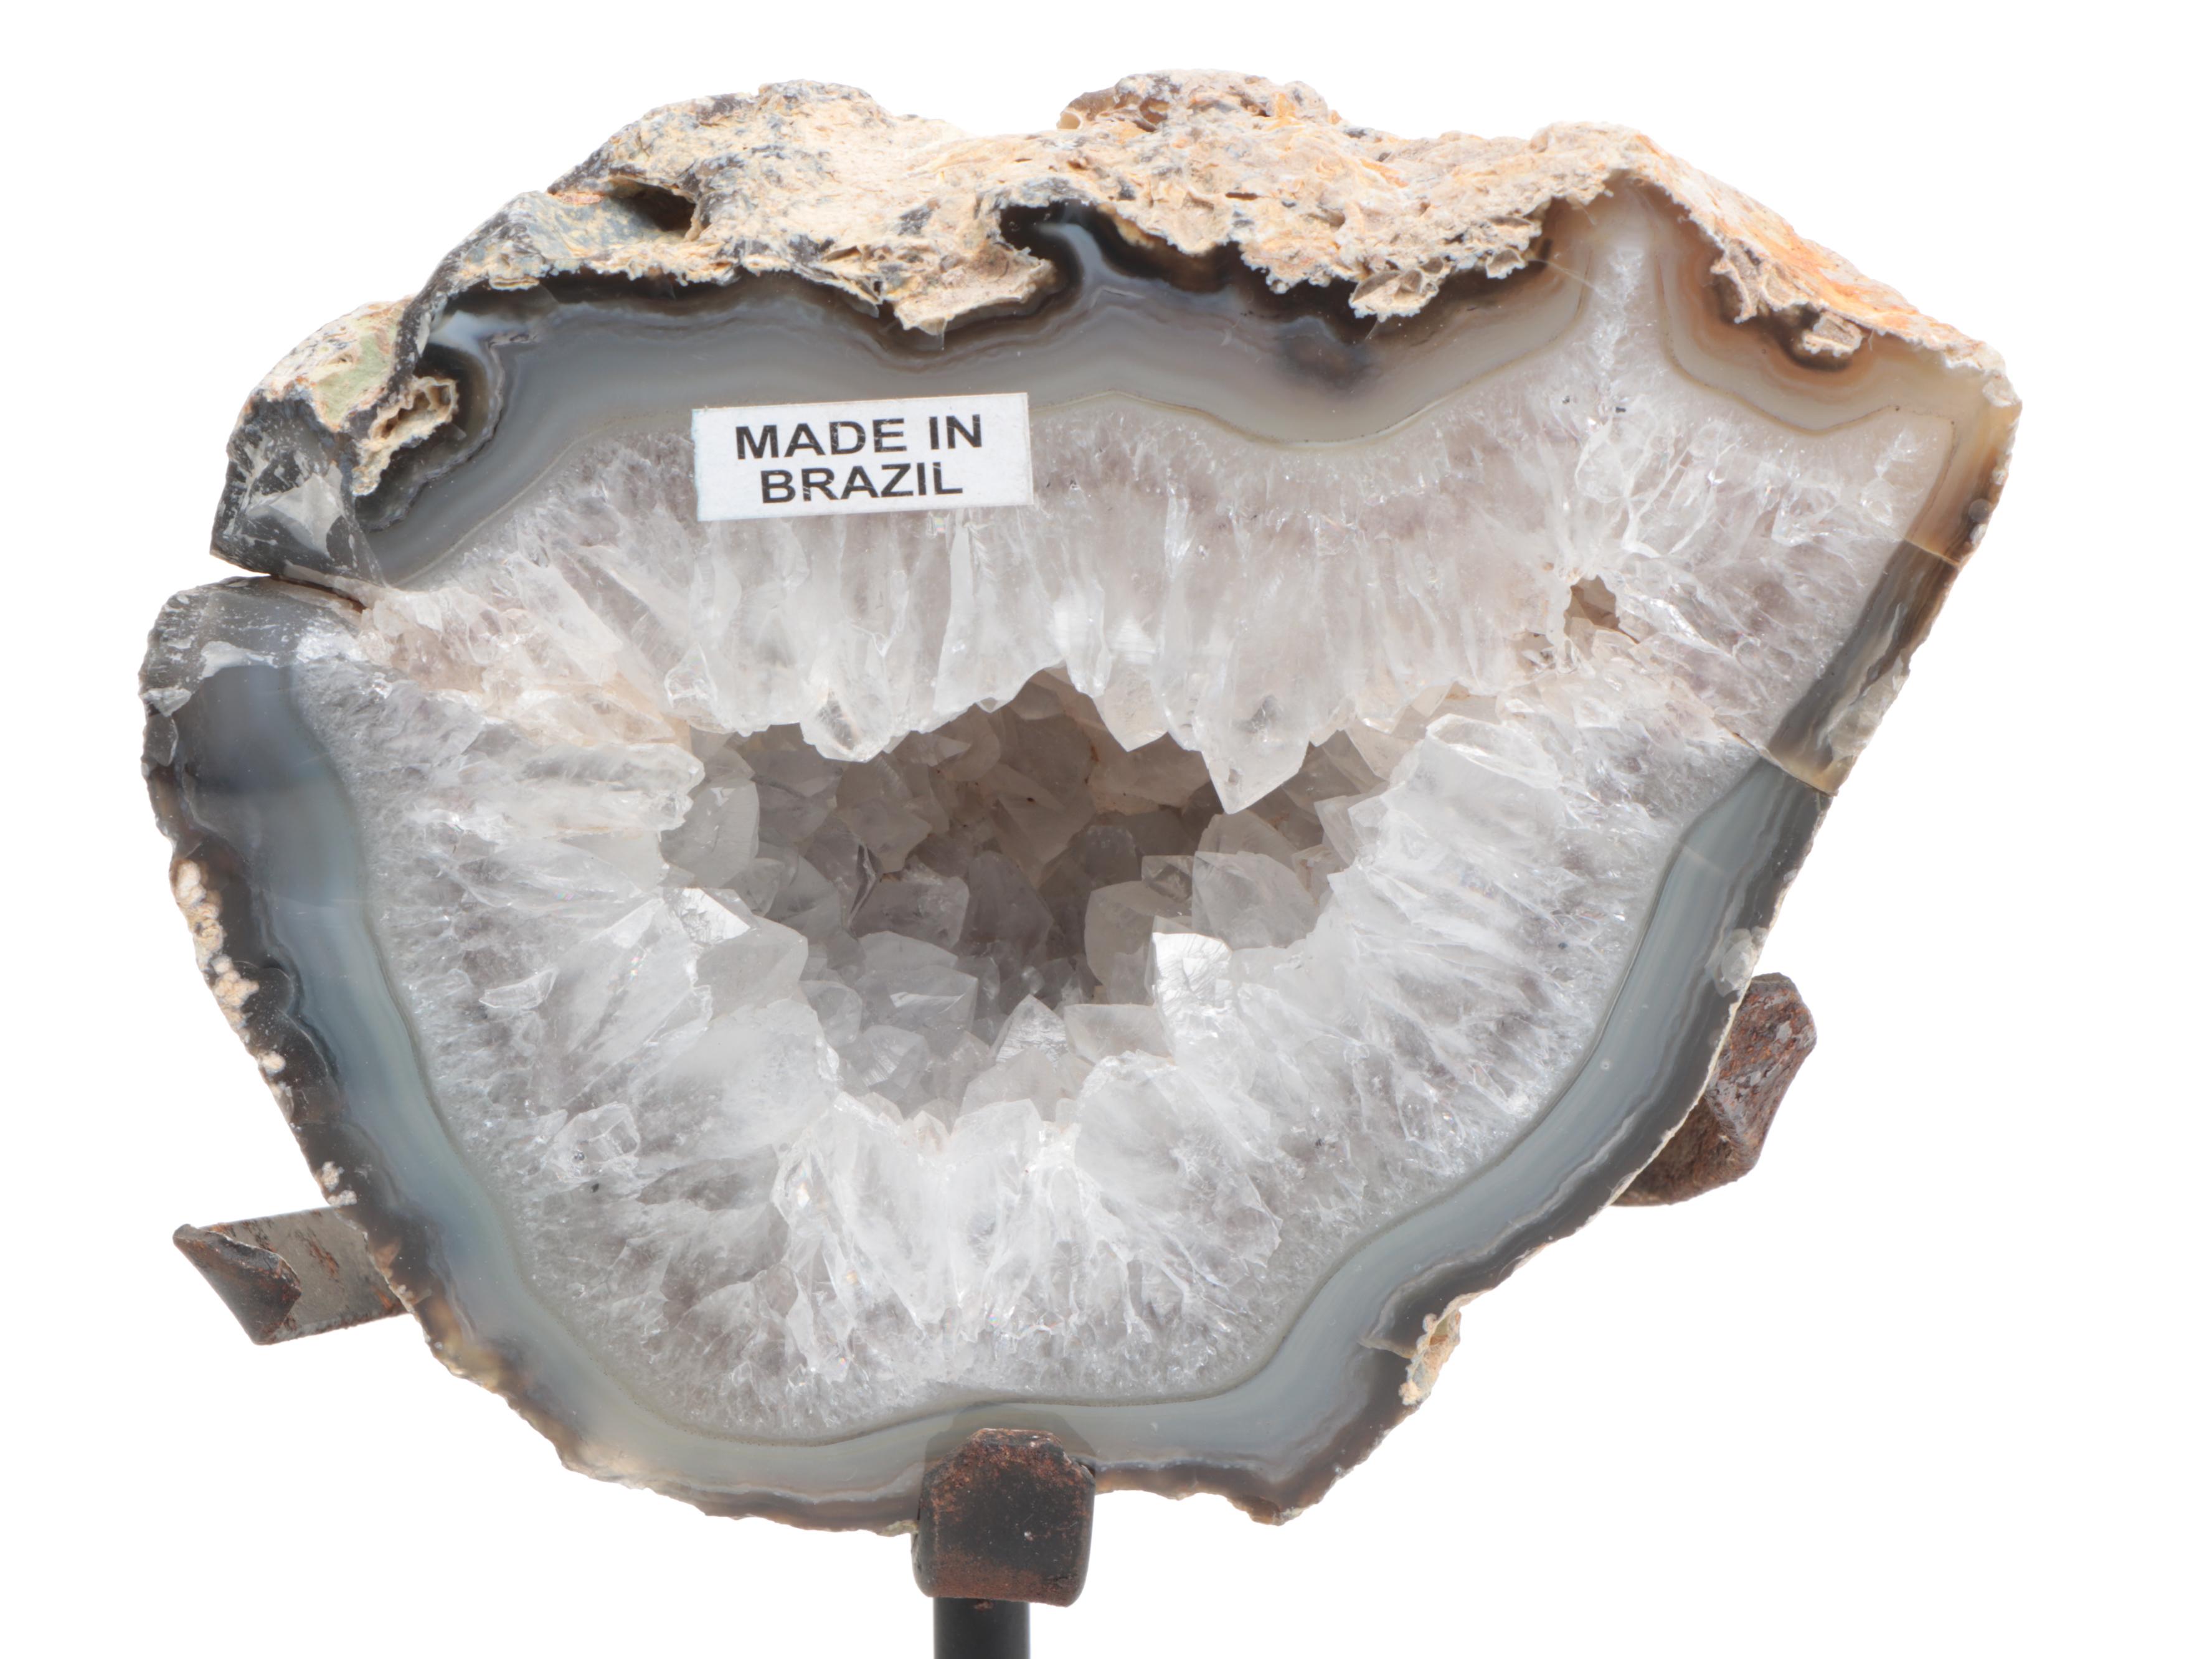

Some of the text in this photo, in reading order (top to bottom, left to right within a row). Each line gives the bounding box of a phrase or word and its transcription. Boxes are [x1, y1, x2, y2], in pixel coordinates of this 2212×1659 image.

[735, 414, 983, 460] MADE IN
[760, 461, 963, 504] BRAZIL
